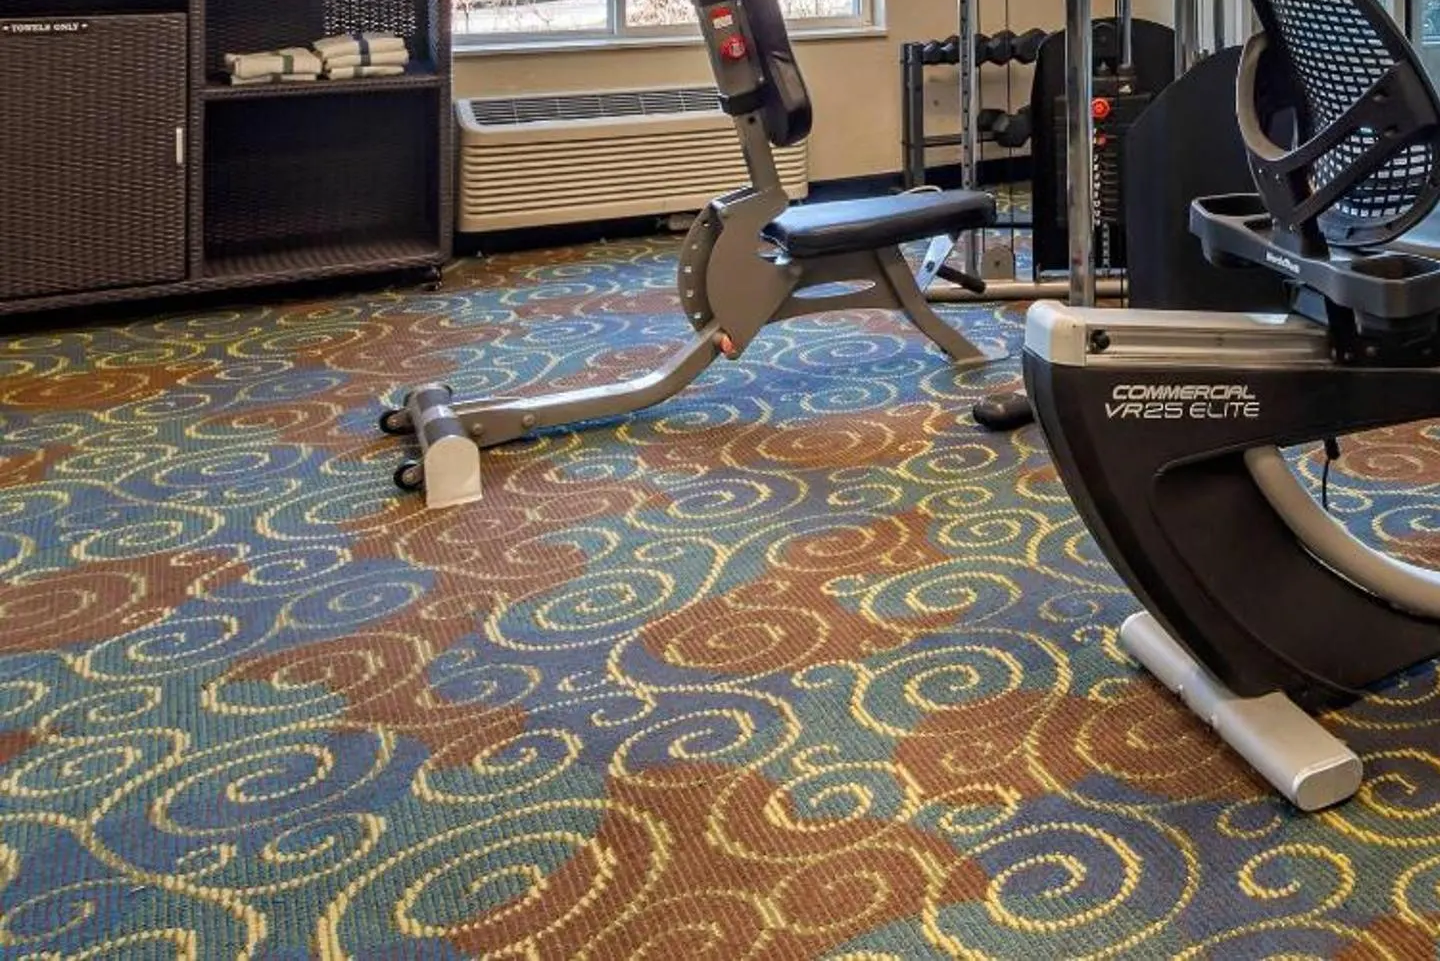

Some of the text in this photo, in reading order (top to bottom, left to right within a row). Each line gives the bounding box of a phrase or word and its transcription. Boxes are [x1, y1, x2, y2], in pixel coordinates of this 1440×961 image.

[11, 21, 80, 33] TOWELS ONLY
[1112, 384, 1257, 400] COMMERCIAL
[1104, 401, 1261, 419] VR25 ELITE
